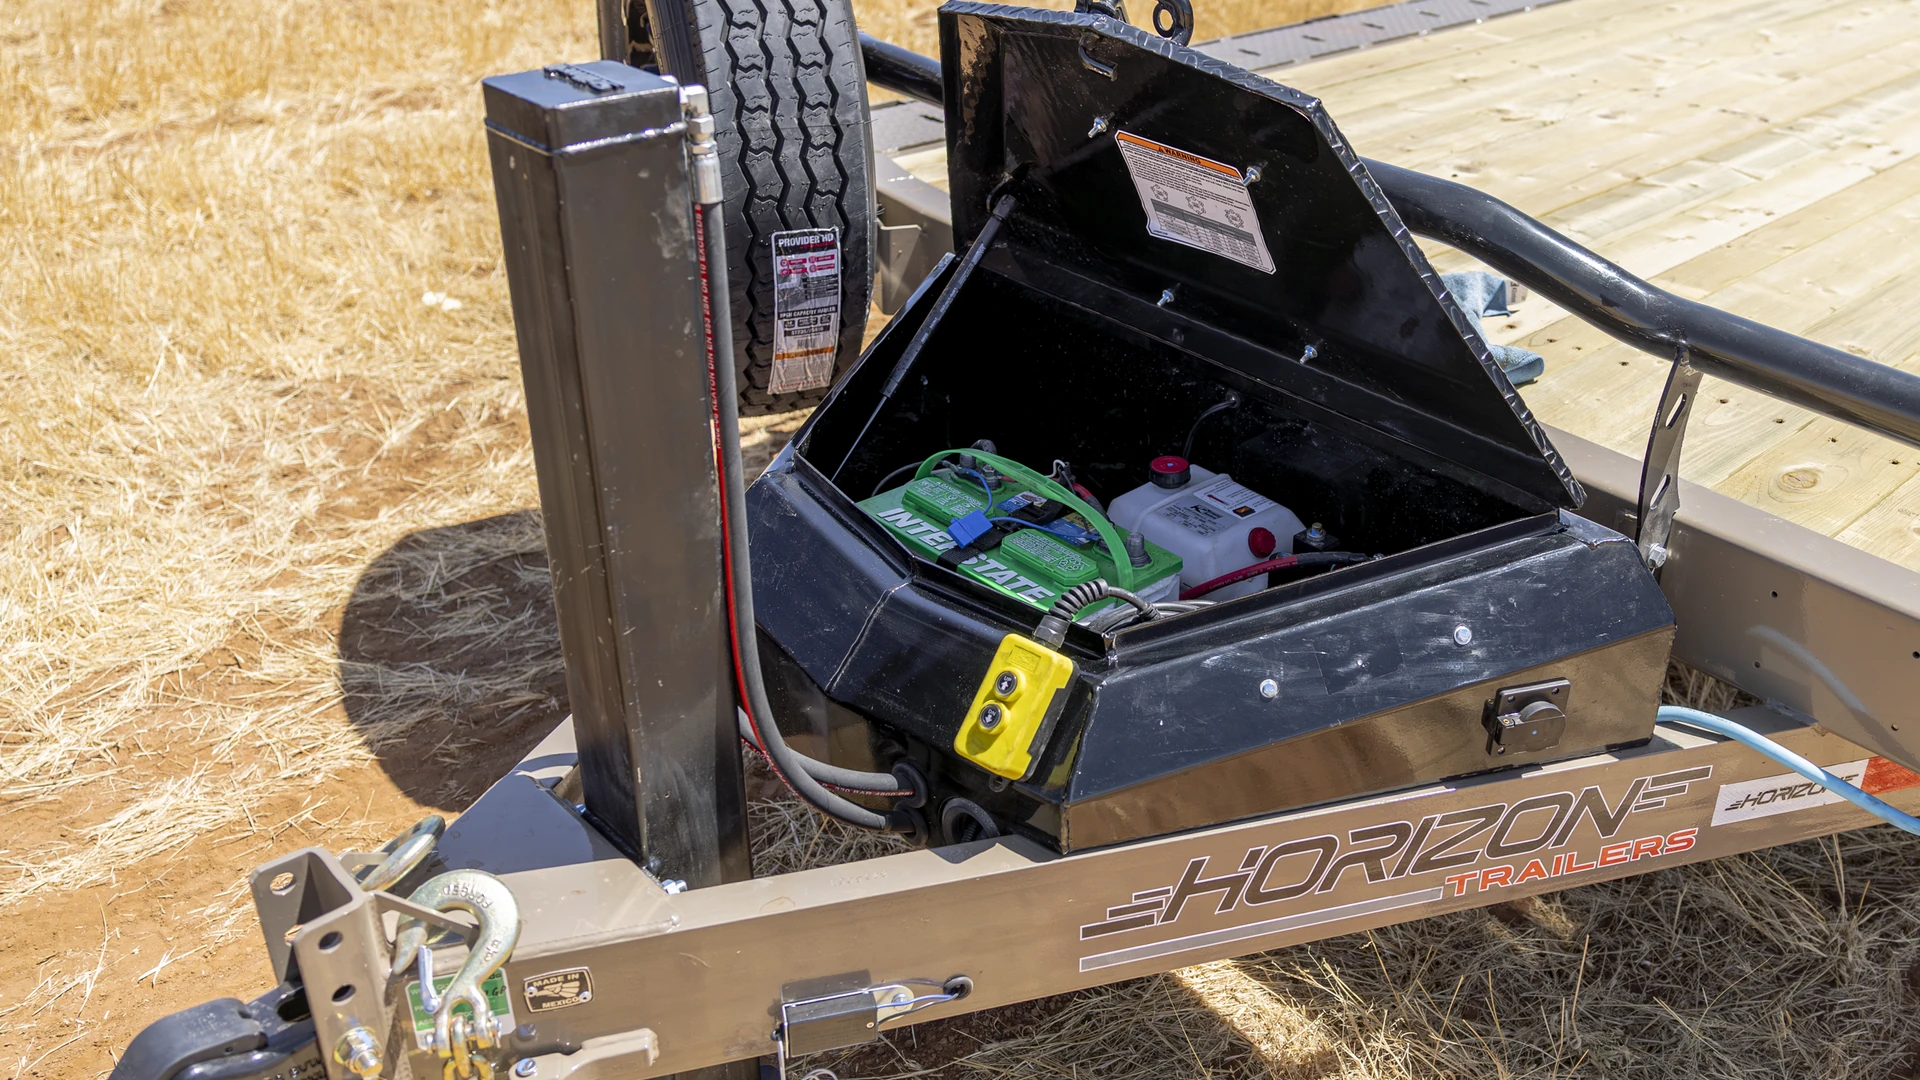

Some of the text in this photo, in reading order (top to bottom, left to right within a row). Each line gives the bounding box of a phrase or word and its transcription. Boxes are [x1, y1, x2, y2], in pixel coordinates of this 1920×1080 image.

[695, 213, 706, 261] EXCEEDS
[778, 234, 820, 248] PROVIDER
[822, 232, 834, 243] HD
[701, 278, 709, 293] DN
[705, 336, 714, 351] EN
[1155, 776, 1652, 926] HORIZON
[1444, 827, 1699, 897] TRAILERS
[533, 973, 580, 987] MADE IN
[542, 996, 580, 1009] MEXICO
